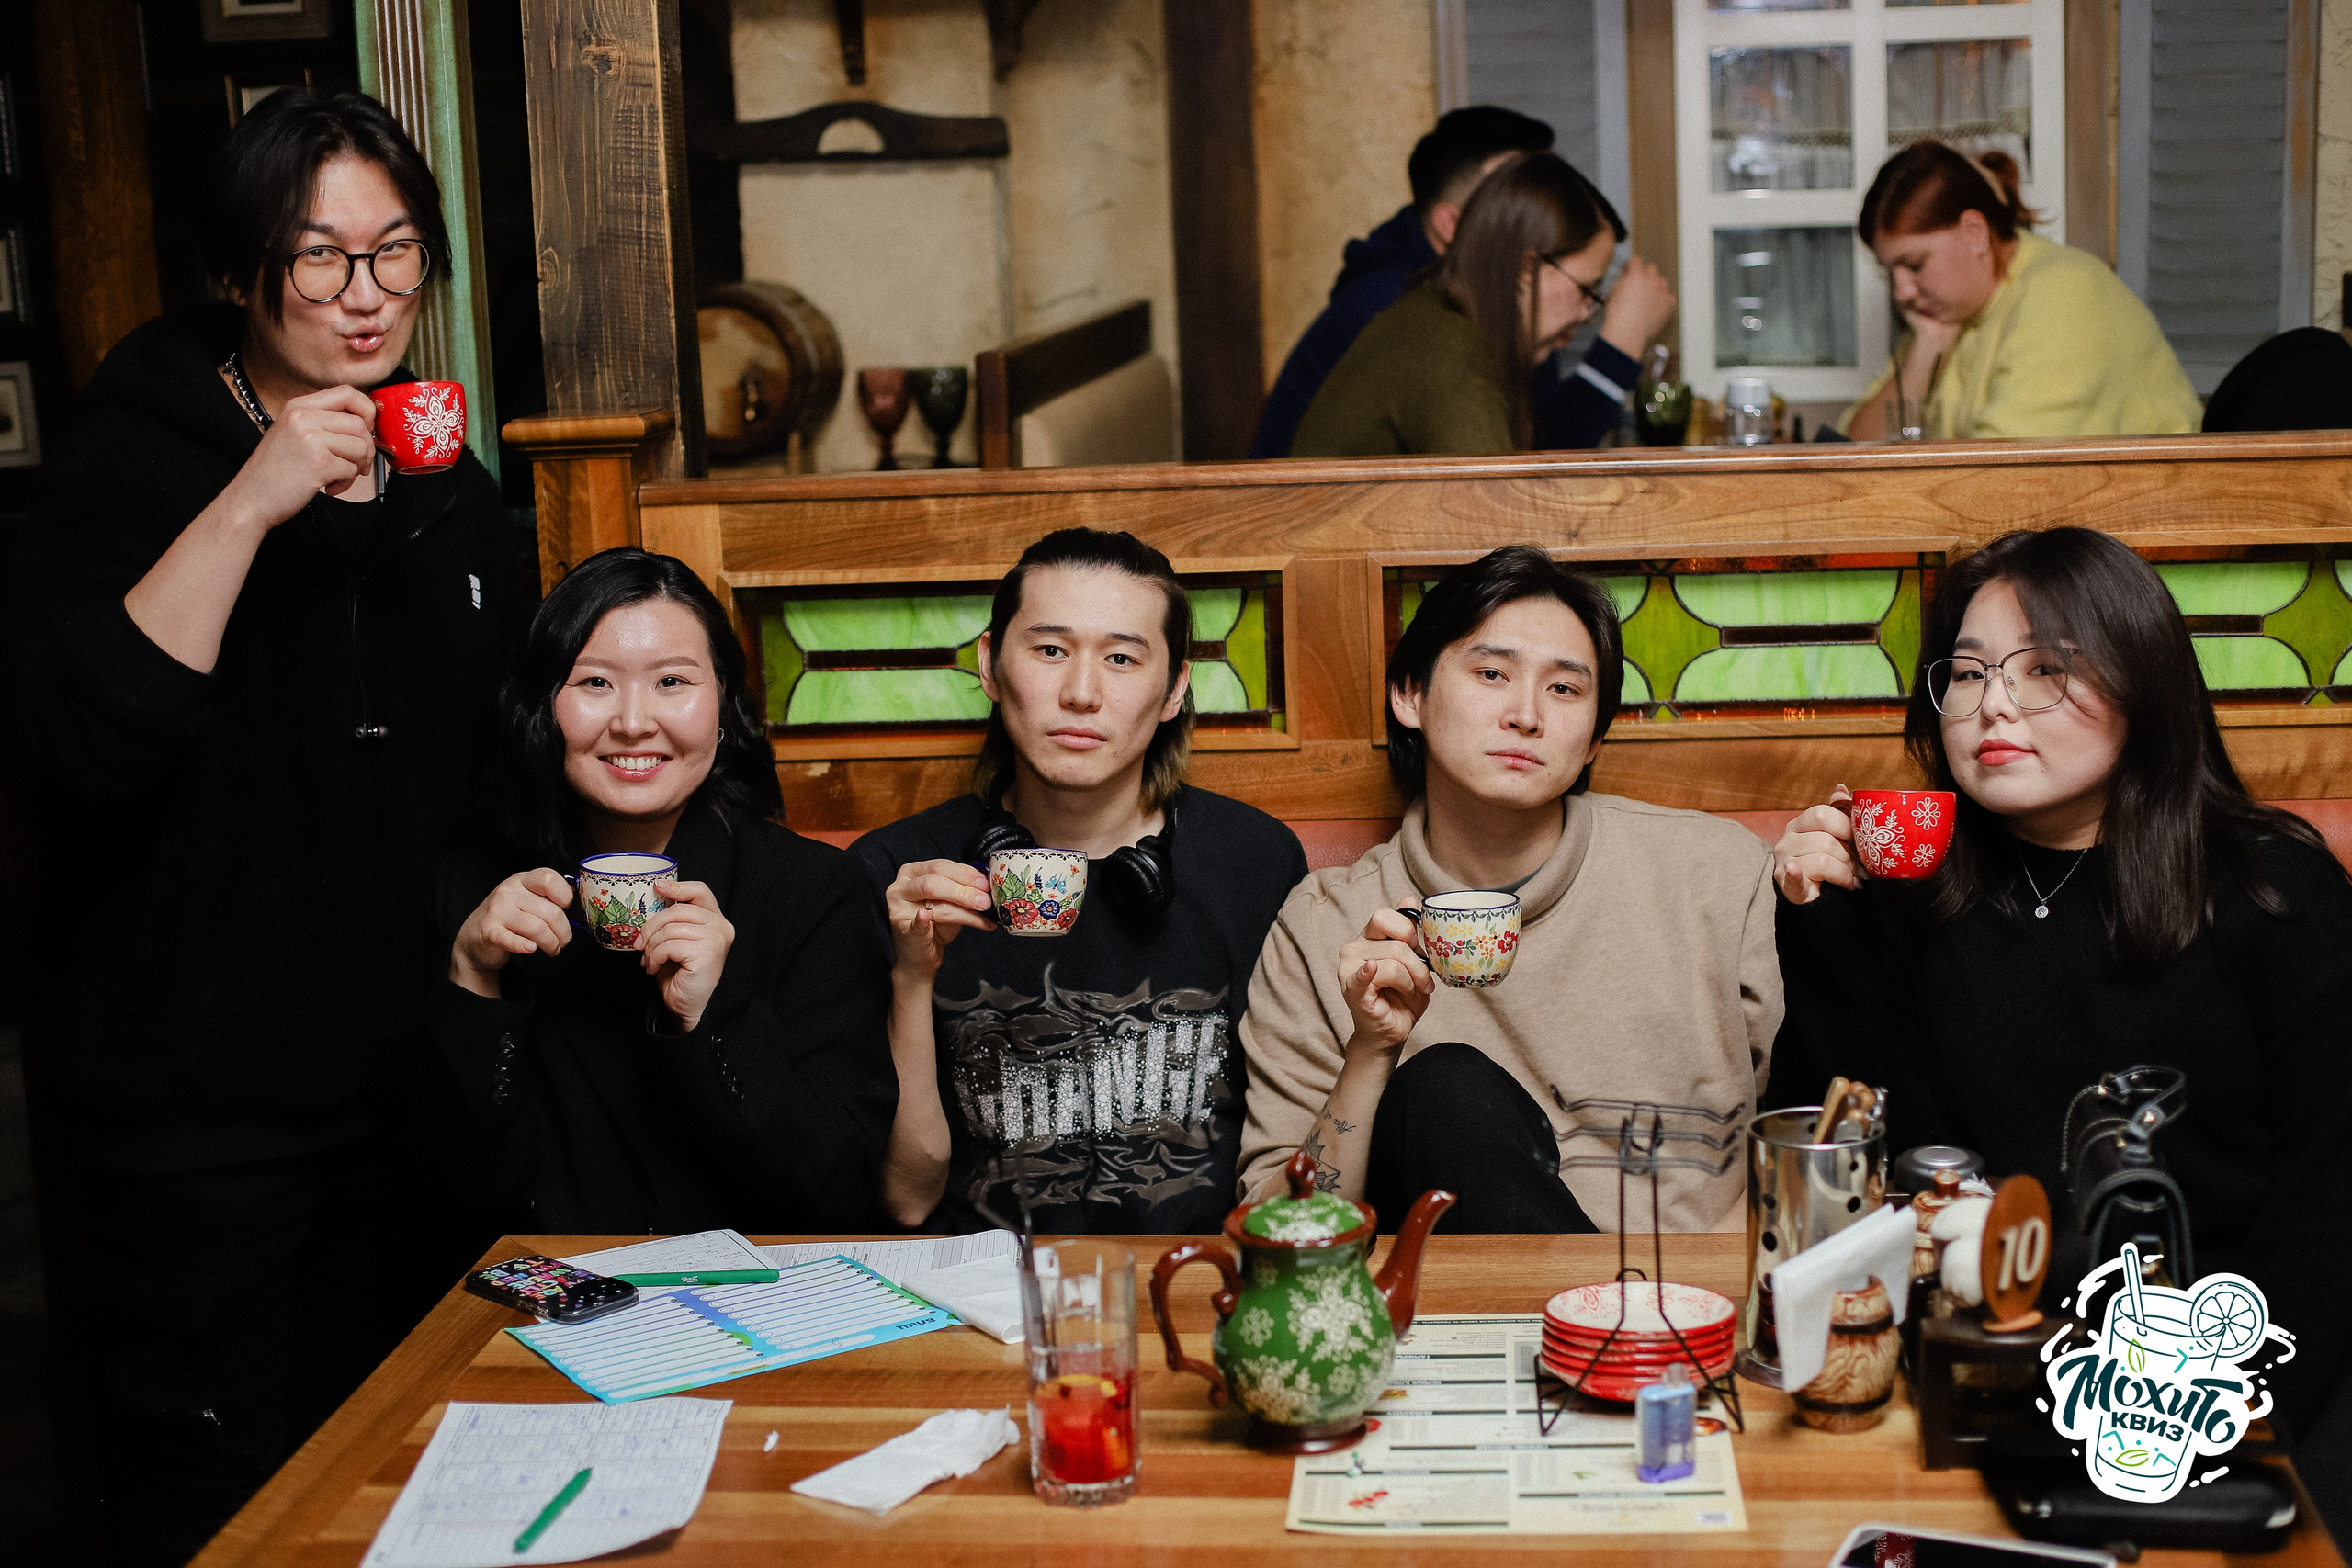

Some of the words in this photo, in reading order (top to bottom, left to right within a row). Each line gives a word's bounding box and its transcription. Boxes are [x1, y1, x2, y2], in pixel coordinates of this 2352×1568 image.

[1997, 1217, 2046, 1292] 10
[478, 1269, 506, 1281] BE
[507, 1269, 572, 1290] WHERE
[519, 1269, 588, 1296] EACTLY
